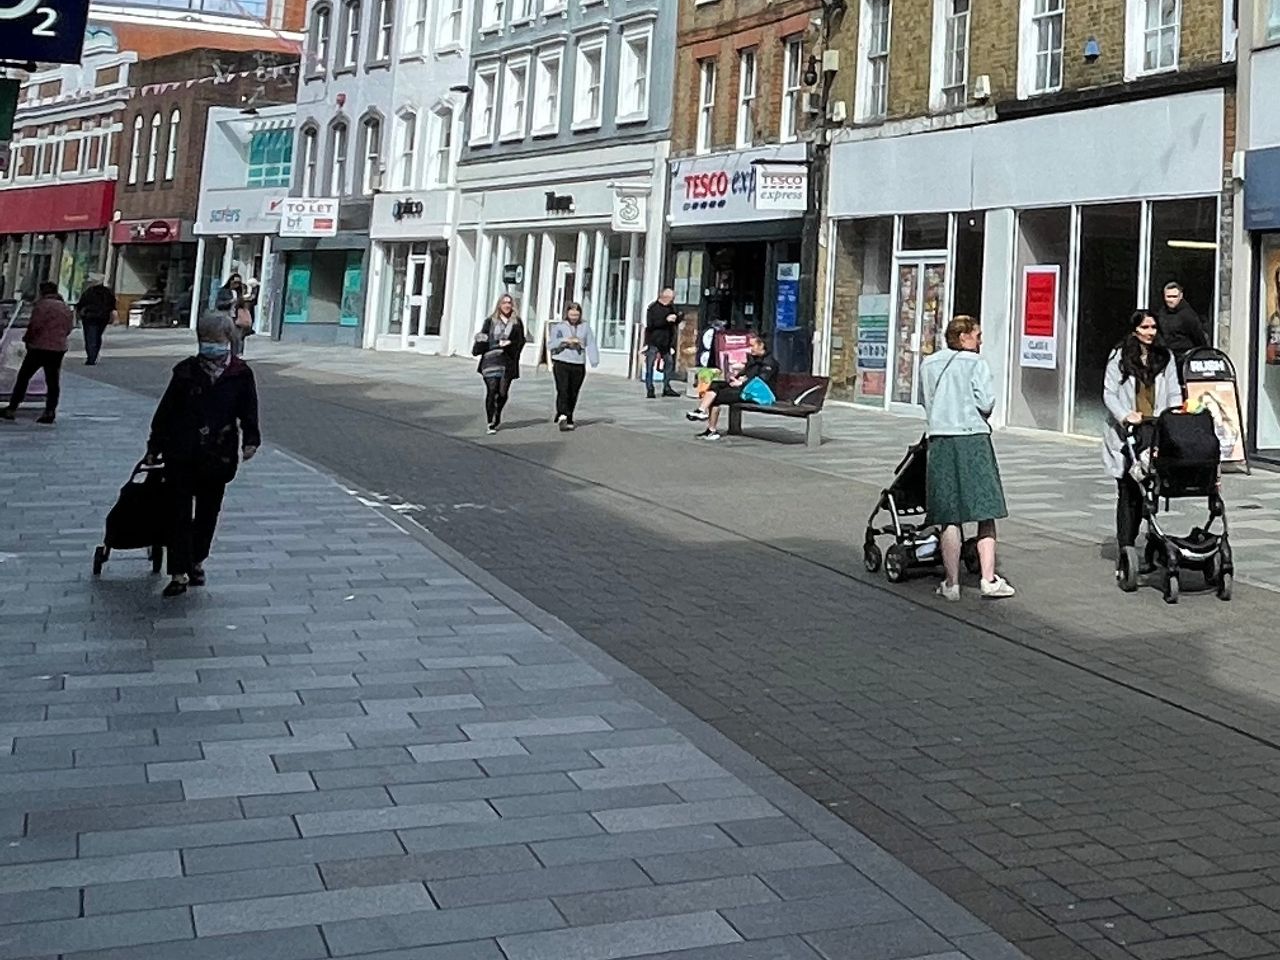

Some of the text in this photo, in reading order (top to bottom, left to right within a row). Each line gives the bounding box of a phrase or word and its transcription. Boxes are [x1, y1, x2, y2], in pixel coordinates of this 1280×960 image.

[684, 171, 728, 199] TESCO
[762, 175, 803, 186] TESCO
[760, 190, 803, 202] express
[287, 203, 333, 213] TO LET
[1190, 360, 1226, 373] RUSH
